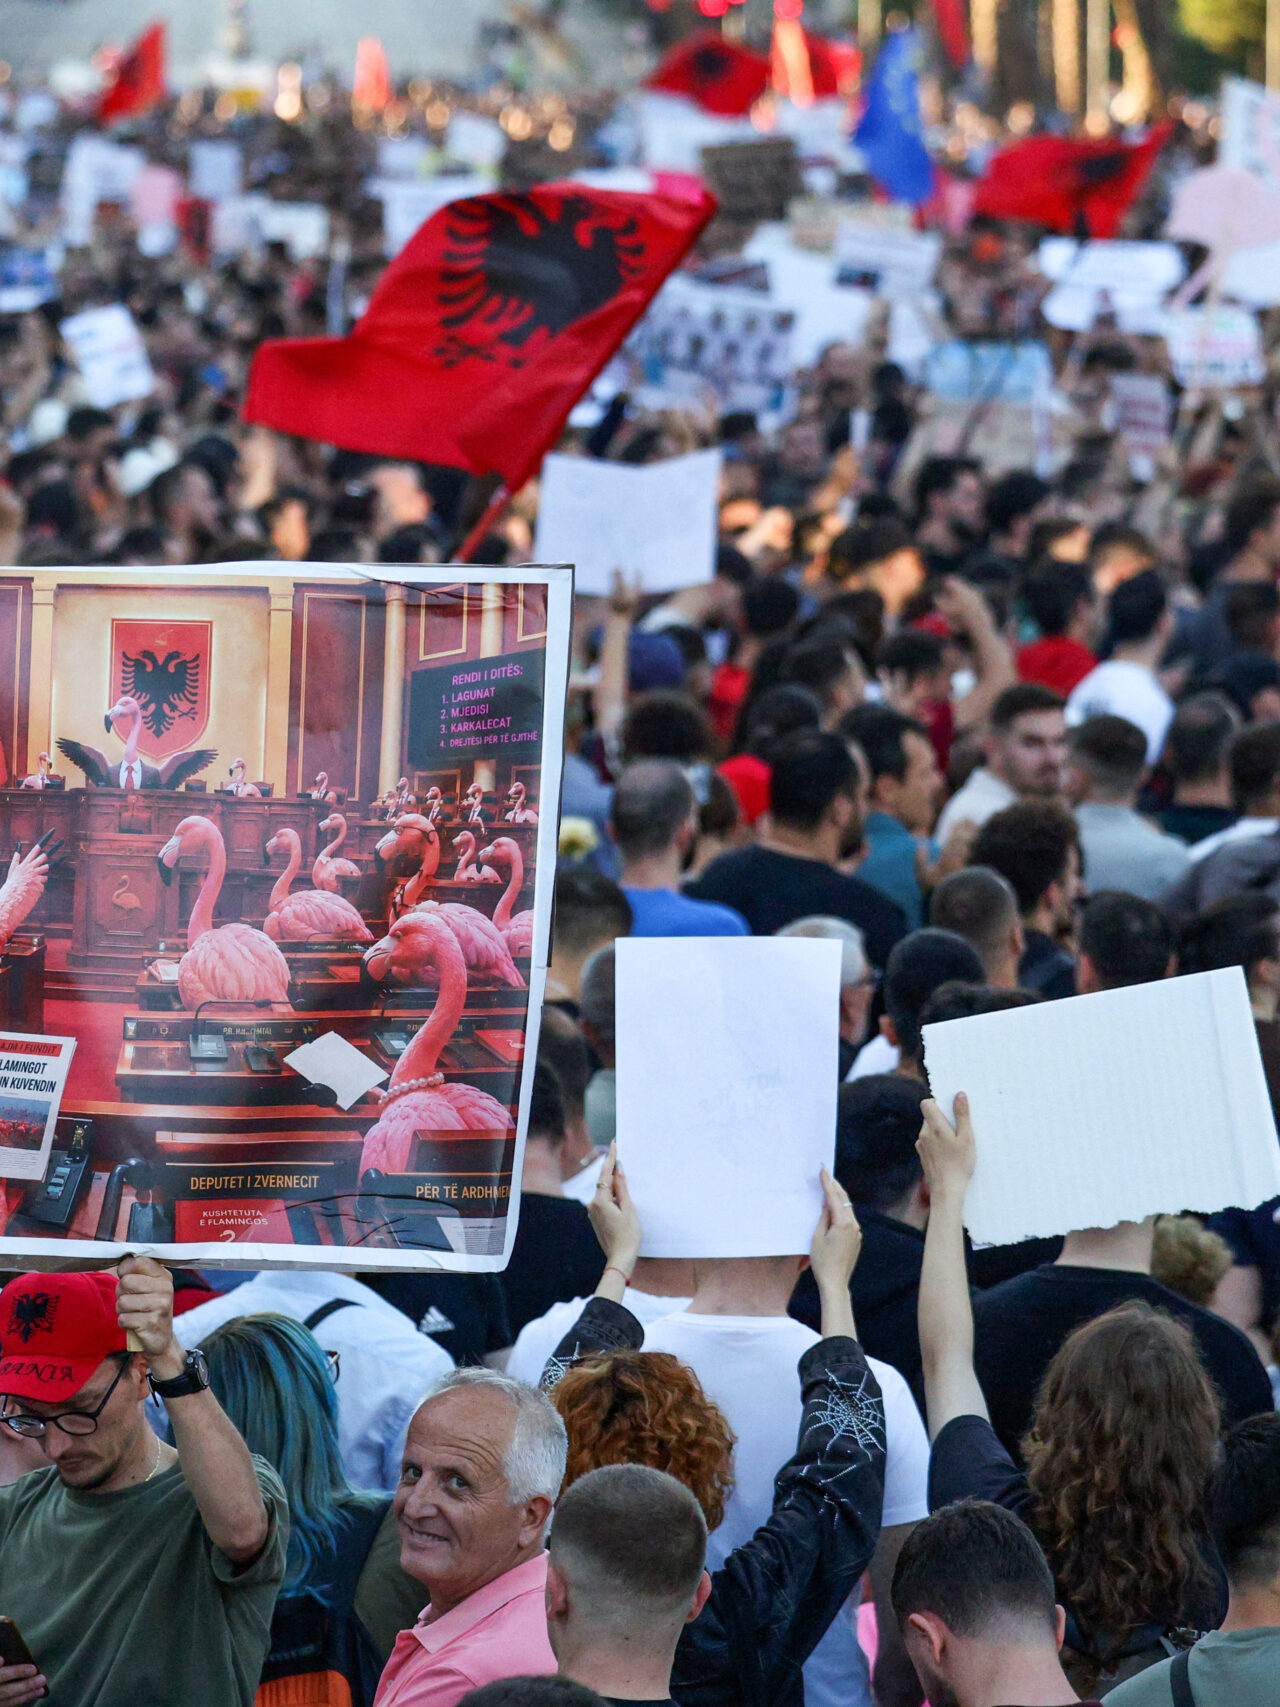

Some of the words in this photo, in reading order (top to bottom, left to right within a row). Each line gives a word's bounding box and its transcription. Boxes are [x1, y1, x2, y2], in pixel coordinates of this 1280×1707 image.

[452, 671, 481, 685] RENDI
[484, 670, 488, 680] I
[490, 664, 523, 679] DITËS:
[442, 694, 448, 704] 1.
[451, 687, 496, 703] LAGUNAT
[440, 709, 448, 719] 2.
[451, 704, 489, 718] MJEDISI
[440, 724, 448, 734] 3.
[450, 716, 512, 733] KARKALECAT
[24, 1043, 57, 1054] FUNDIT
[10, 1077, 57, 1093] KUVENDIN
[190, 1176, 245, 1190] DEPUTET
[247, 1176, 251, 1187] I
[254, 1175, 320, 1188] ZVERNECIT
[416, 1183, 440, 1199] PËR
[443, 1183, 458, 1198] TË
[202, 1209, 263, 1217] KUSHTETUTA
[208, 1217, 268, 1226] FLAMINGOS
